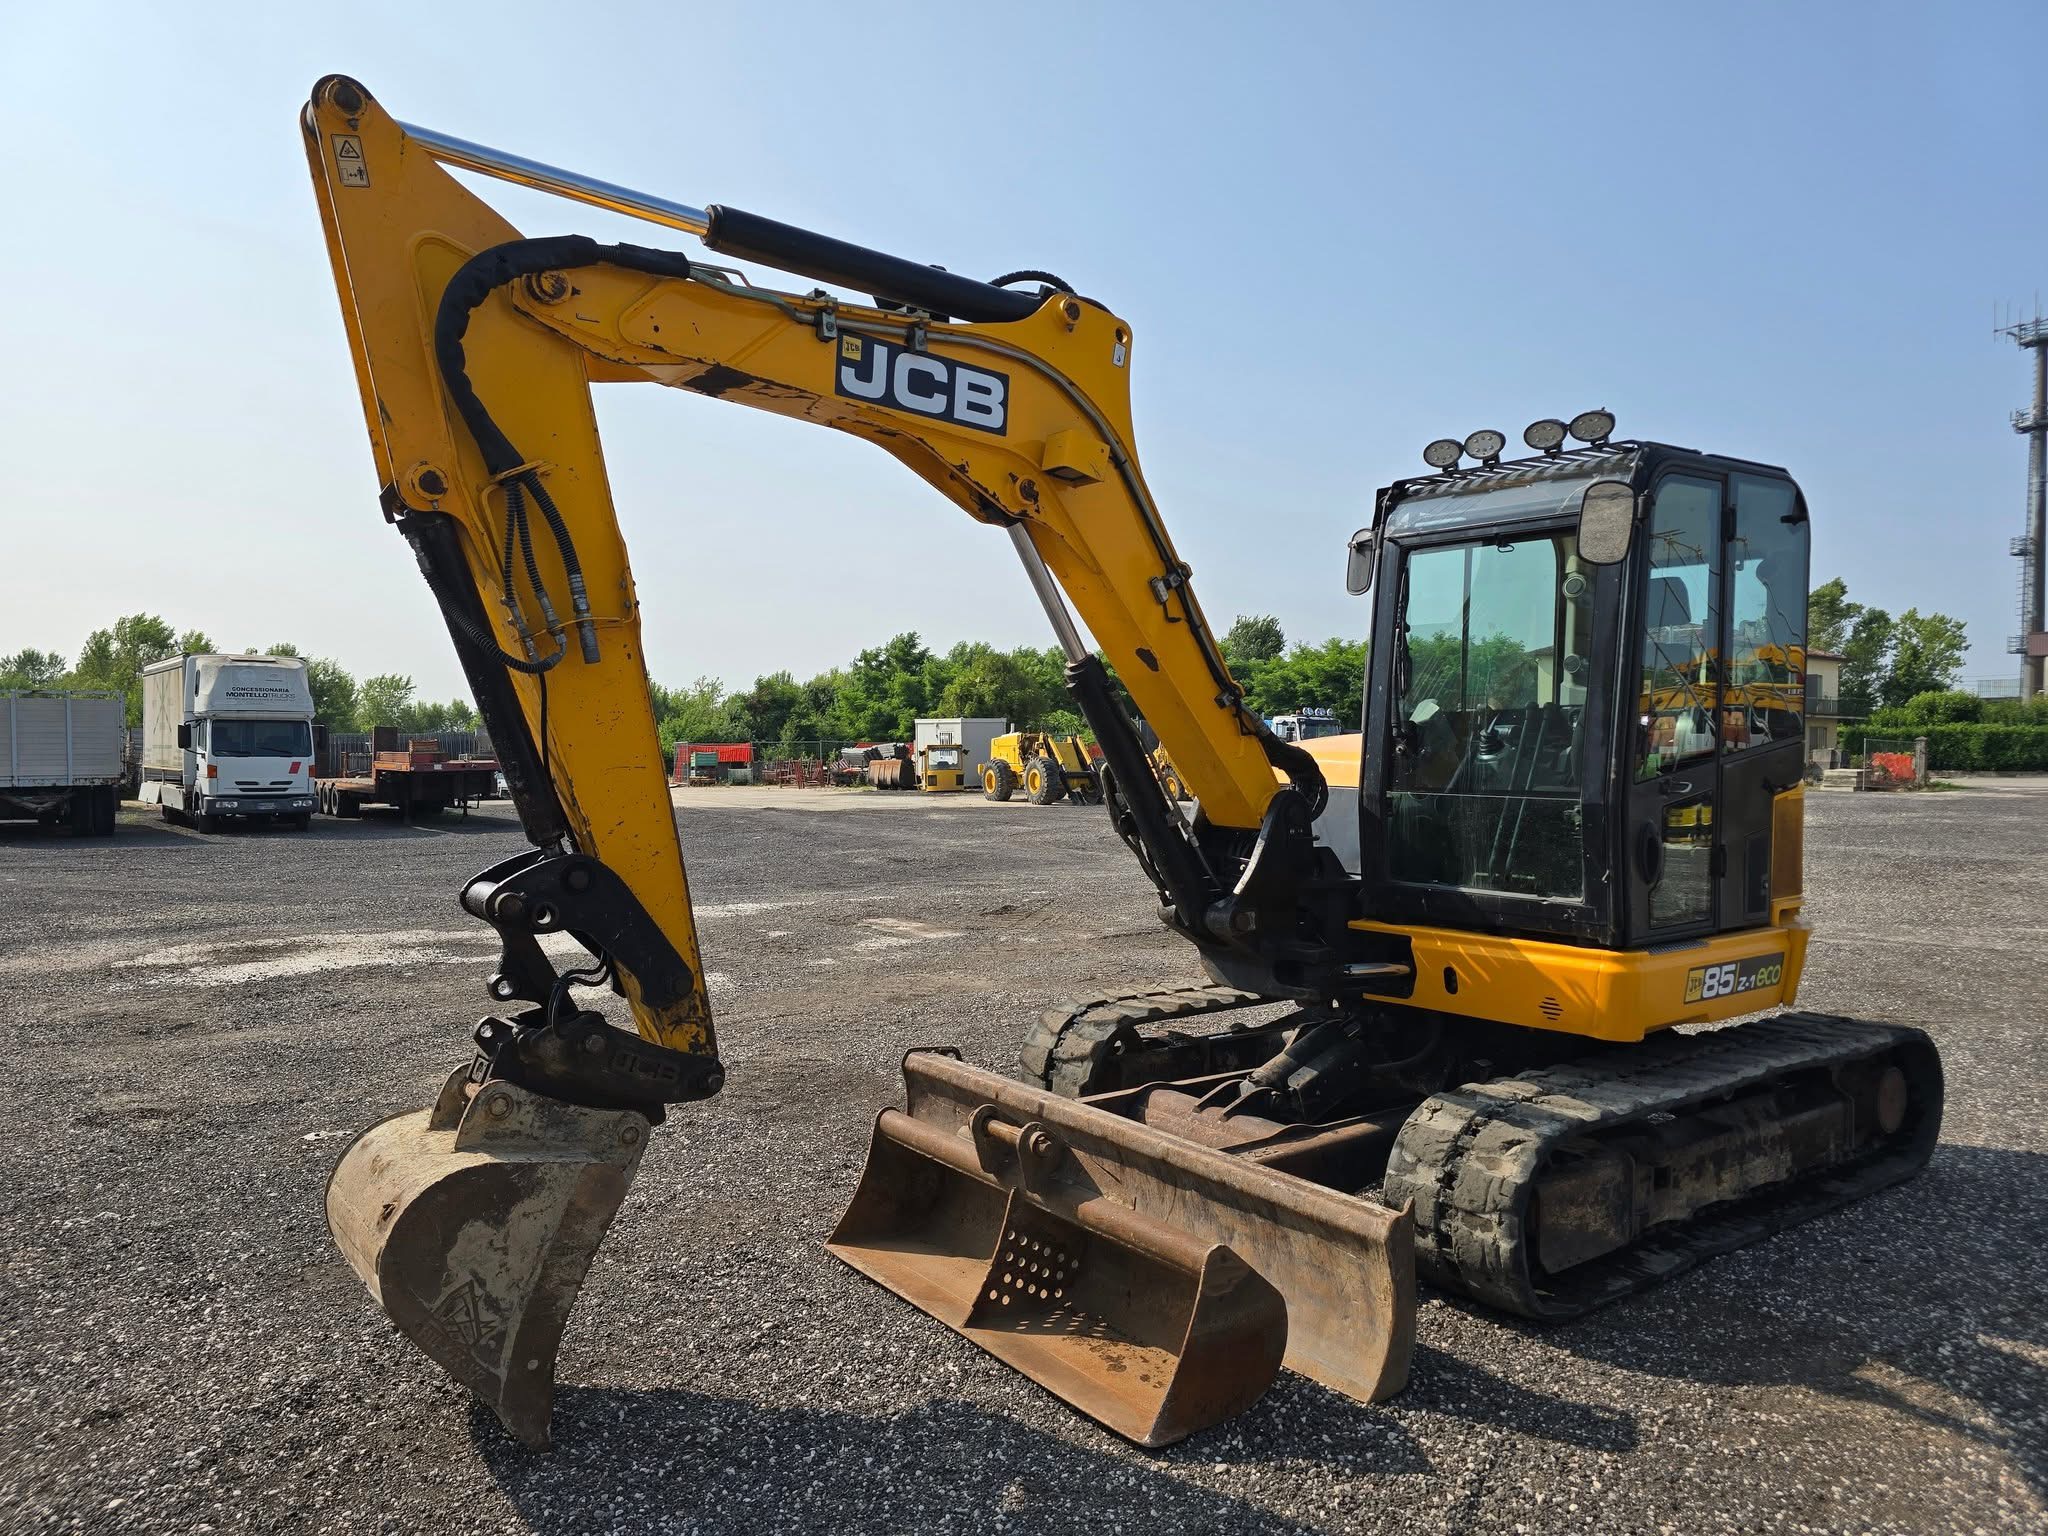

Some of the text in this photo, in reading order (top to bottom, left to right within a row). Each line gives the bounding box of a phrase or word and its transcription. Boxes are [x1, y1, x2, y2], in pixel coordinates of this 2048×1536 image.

[845, 340, 860, 352] JCB
[841, 343, 1005, 429] JCB
[1702, 963, 1737, 999] 85
